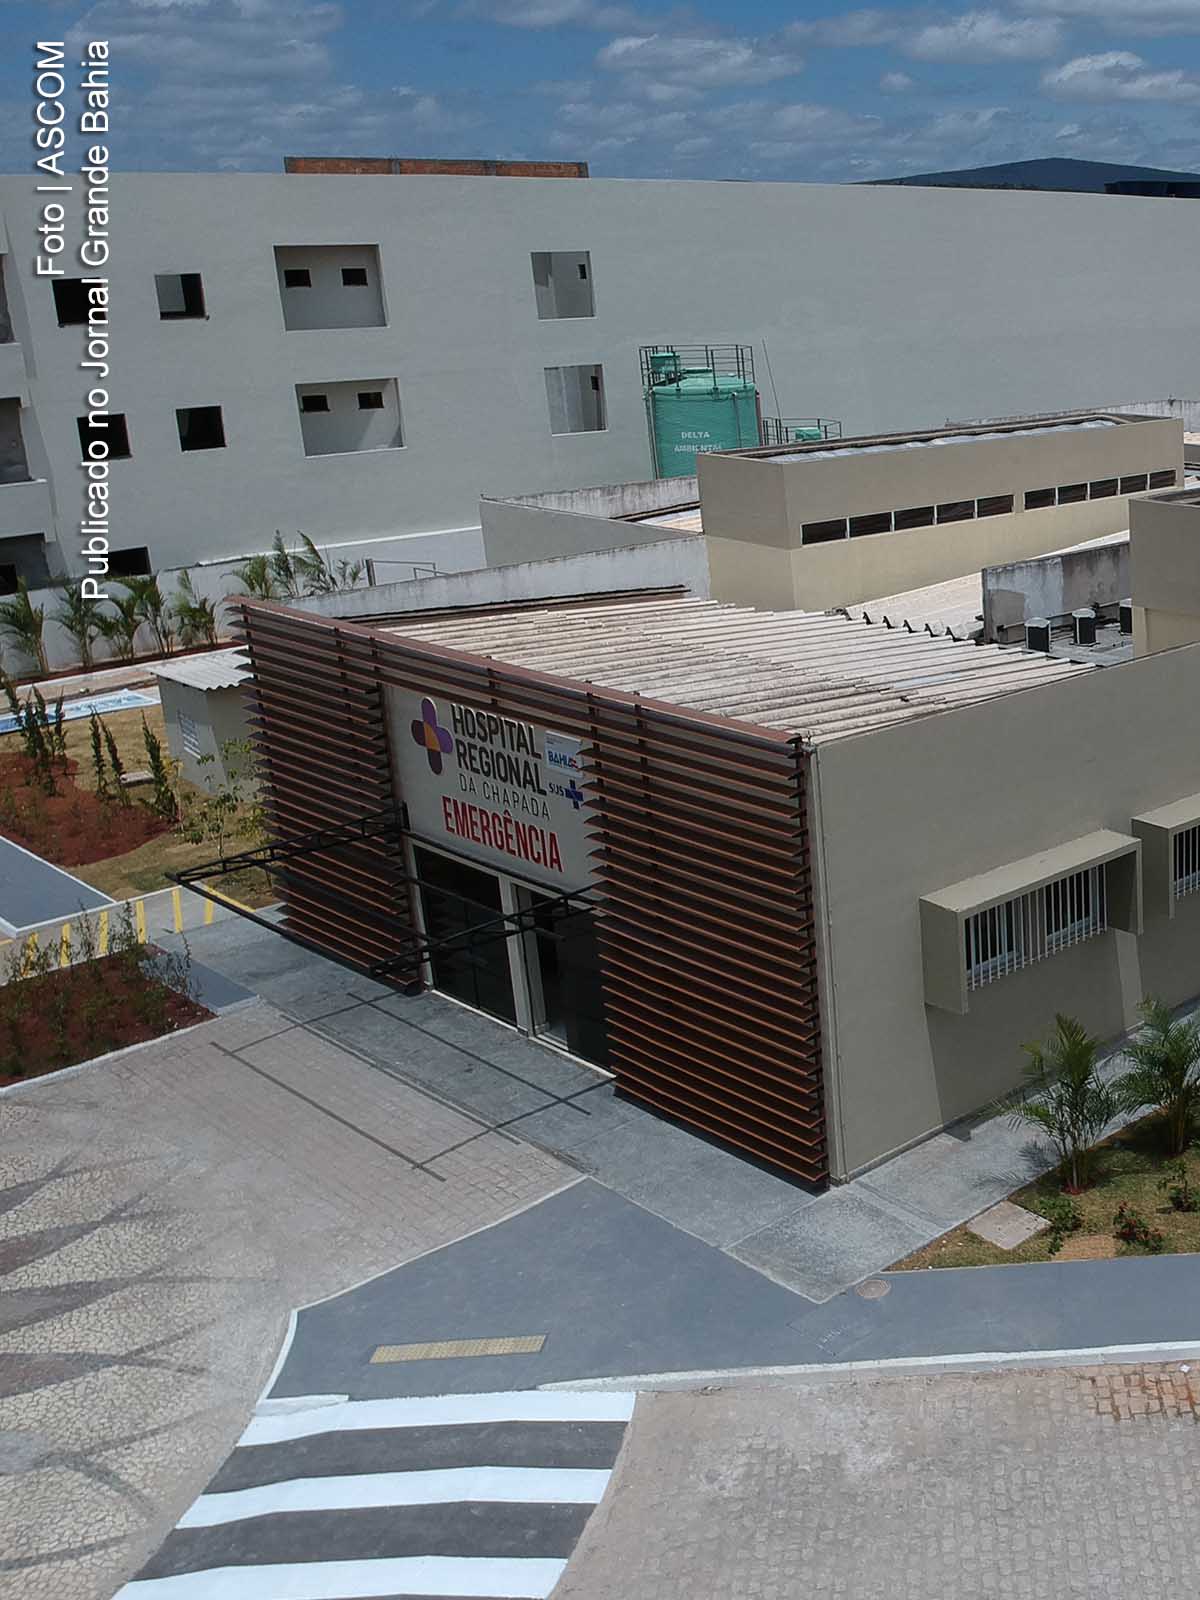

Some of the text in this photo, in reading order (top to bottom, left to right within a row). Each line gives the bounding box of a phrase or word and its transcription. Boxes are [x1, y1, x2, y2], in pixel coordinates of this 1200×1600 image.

[681, 431, 710, 439] DELTA
[451, 703, 541, 759] HOSPITAL
[455, 739, 547, 795] REGIONAL
[459, 773, 551, 821] DA CHAPADA
[441, 795, 563, 873] EMERGÊNCIA
